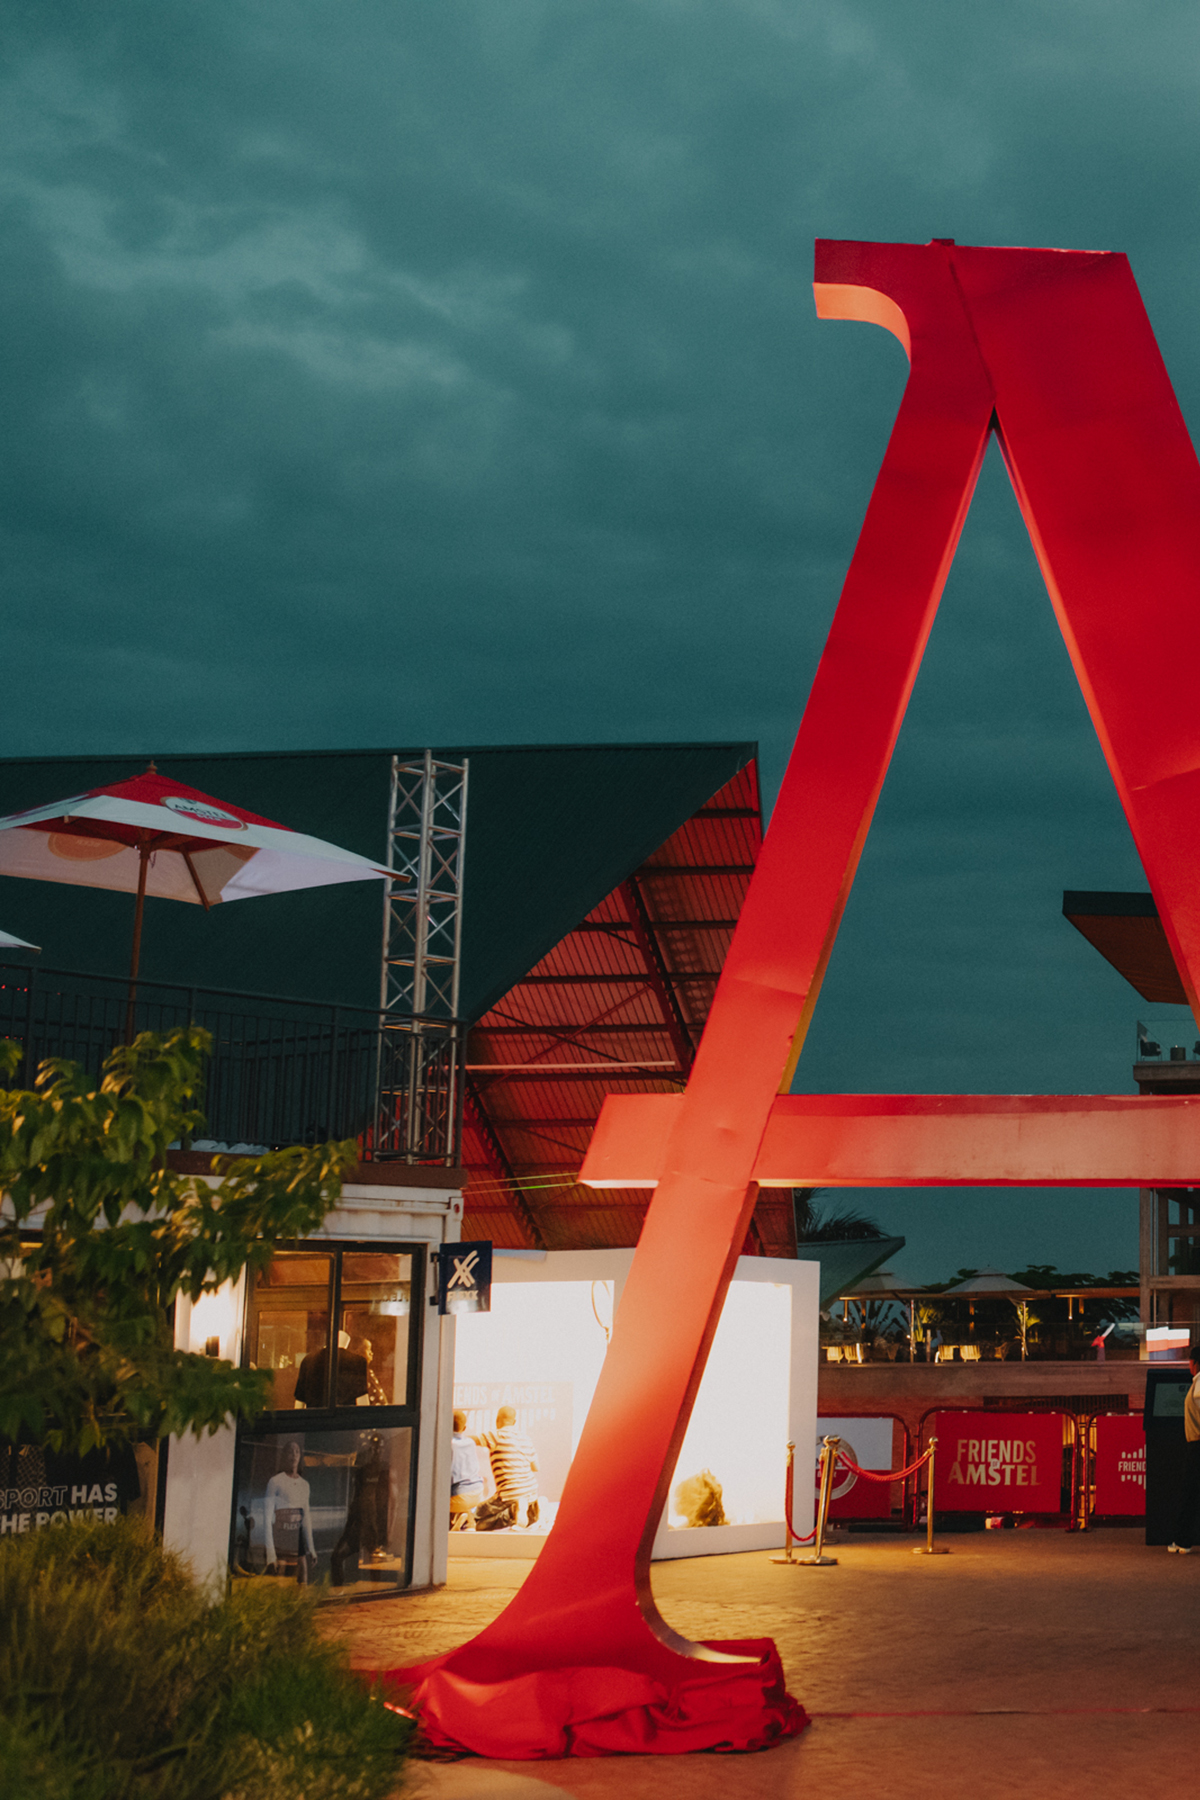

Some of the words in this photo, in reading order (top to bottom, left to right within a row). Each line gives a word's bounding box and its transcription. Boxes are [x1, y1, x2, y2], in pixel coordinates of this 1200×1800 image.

[453, 1385, 488, 1406] IENDS
[957, 1439, 1036, 1463] FRIENDS
[947, 1462, 1042, 1486] AMSTEL
[1118, 1461, 1146, 1472] FRIEND
[71, 1482, 118, 1504] HAS
[0, 1513, 31, 1535] HE
